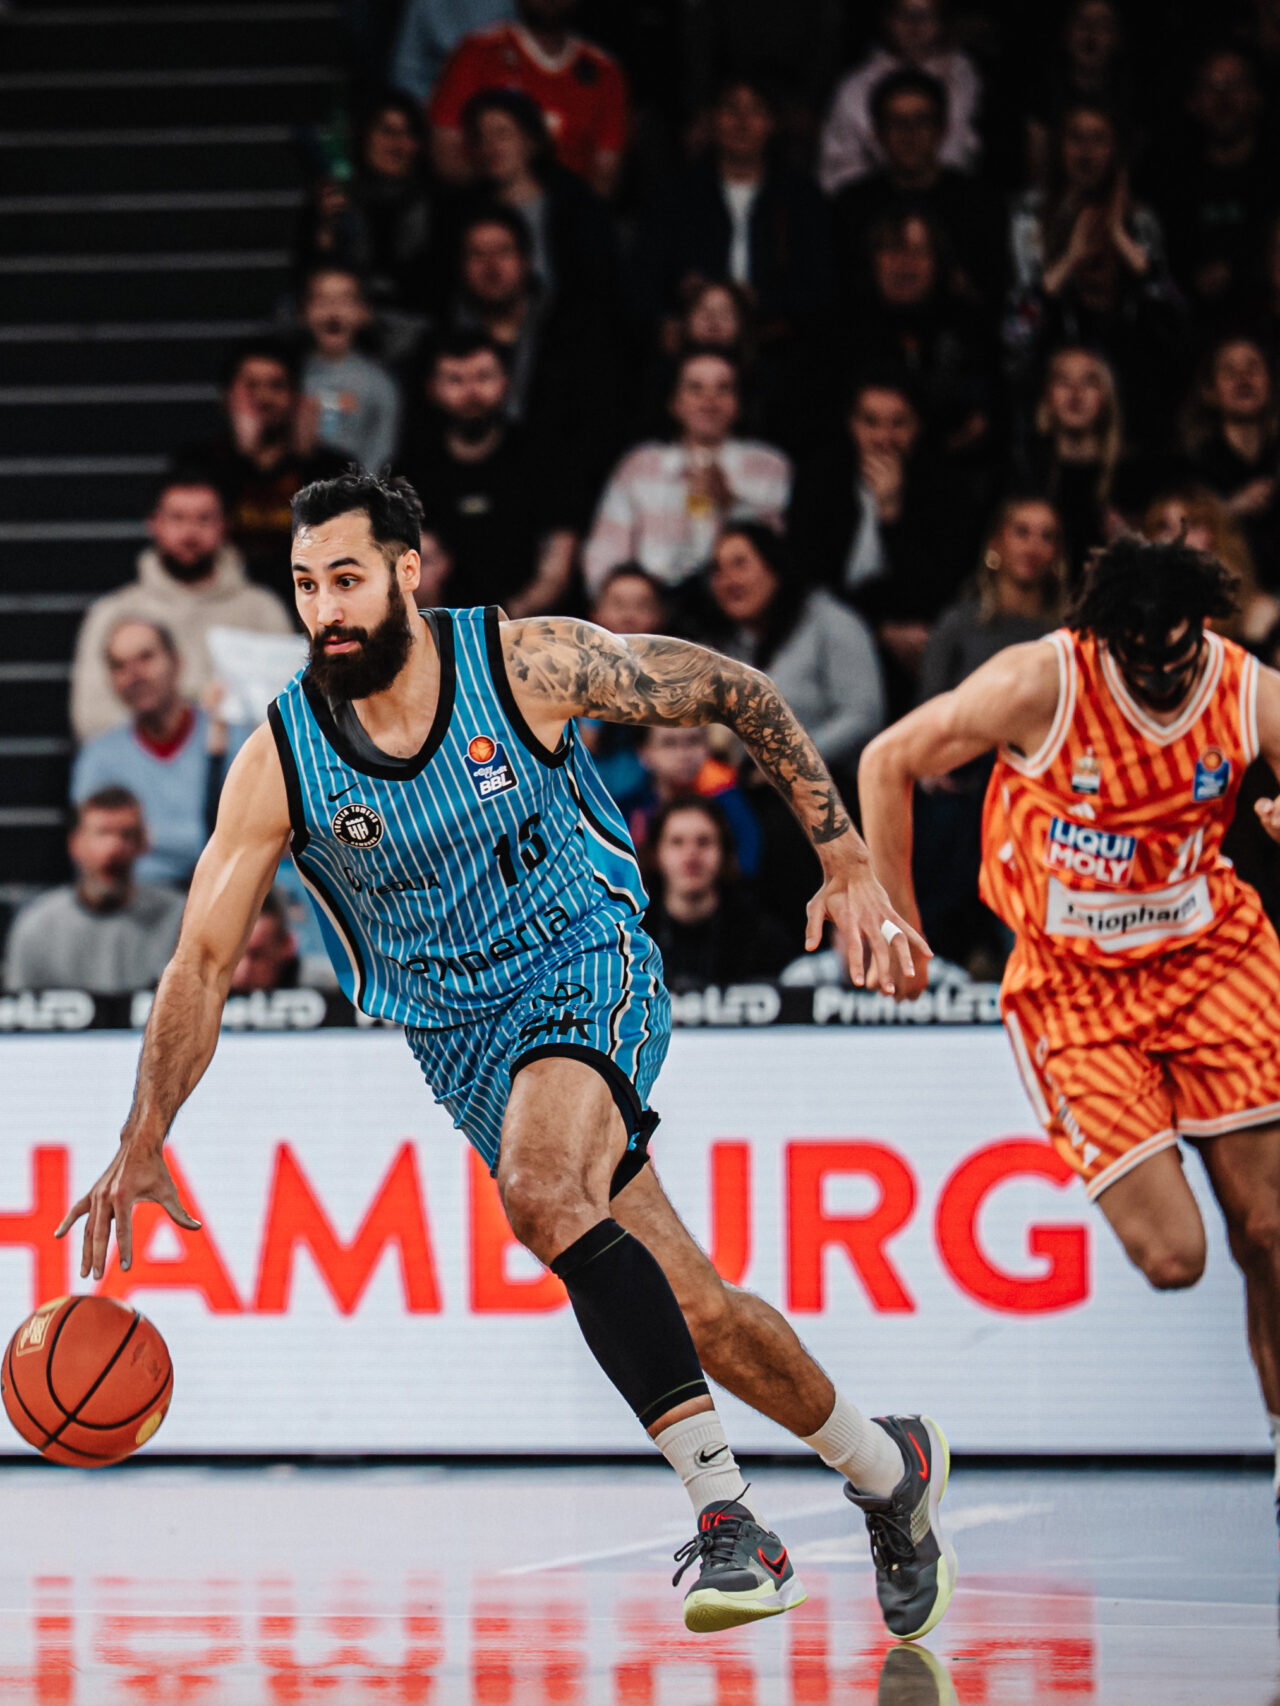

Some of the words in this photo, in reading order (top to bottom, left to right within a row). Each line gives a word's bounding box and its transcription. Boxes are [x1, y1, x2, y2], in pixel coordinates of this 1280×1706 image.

[479, 773, 513, 796] BBL
[1052, 819, 1132, 860] LIQUI
[1049, 842, 1128, 884] MOLY
[364, 873, 443, 897] VEOLIA
[1067, 895, 1197, 934] tiopharm
